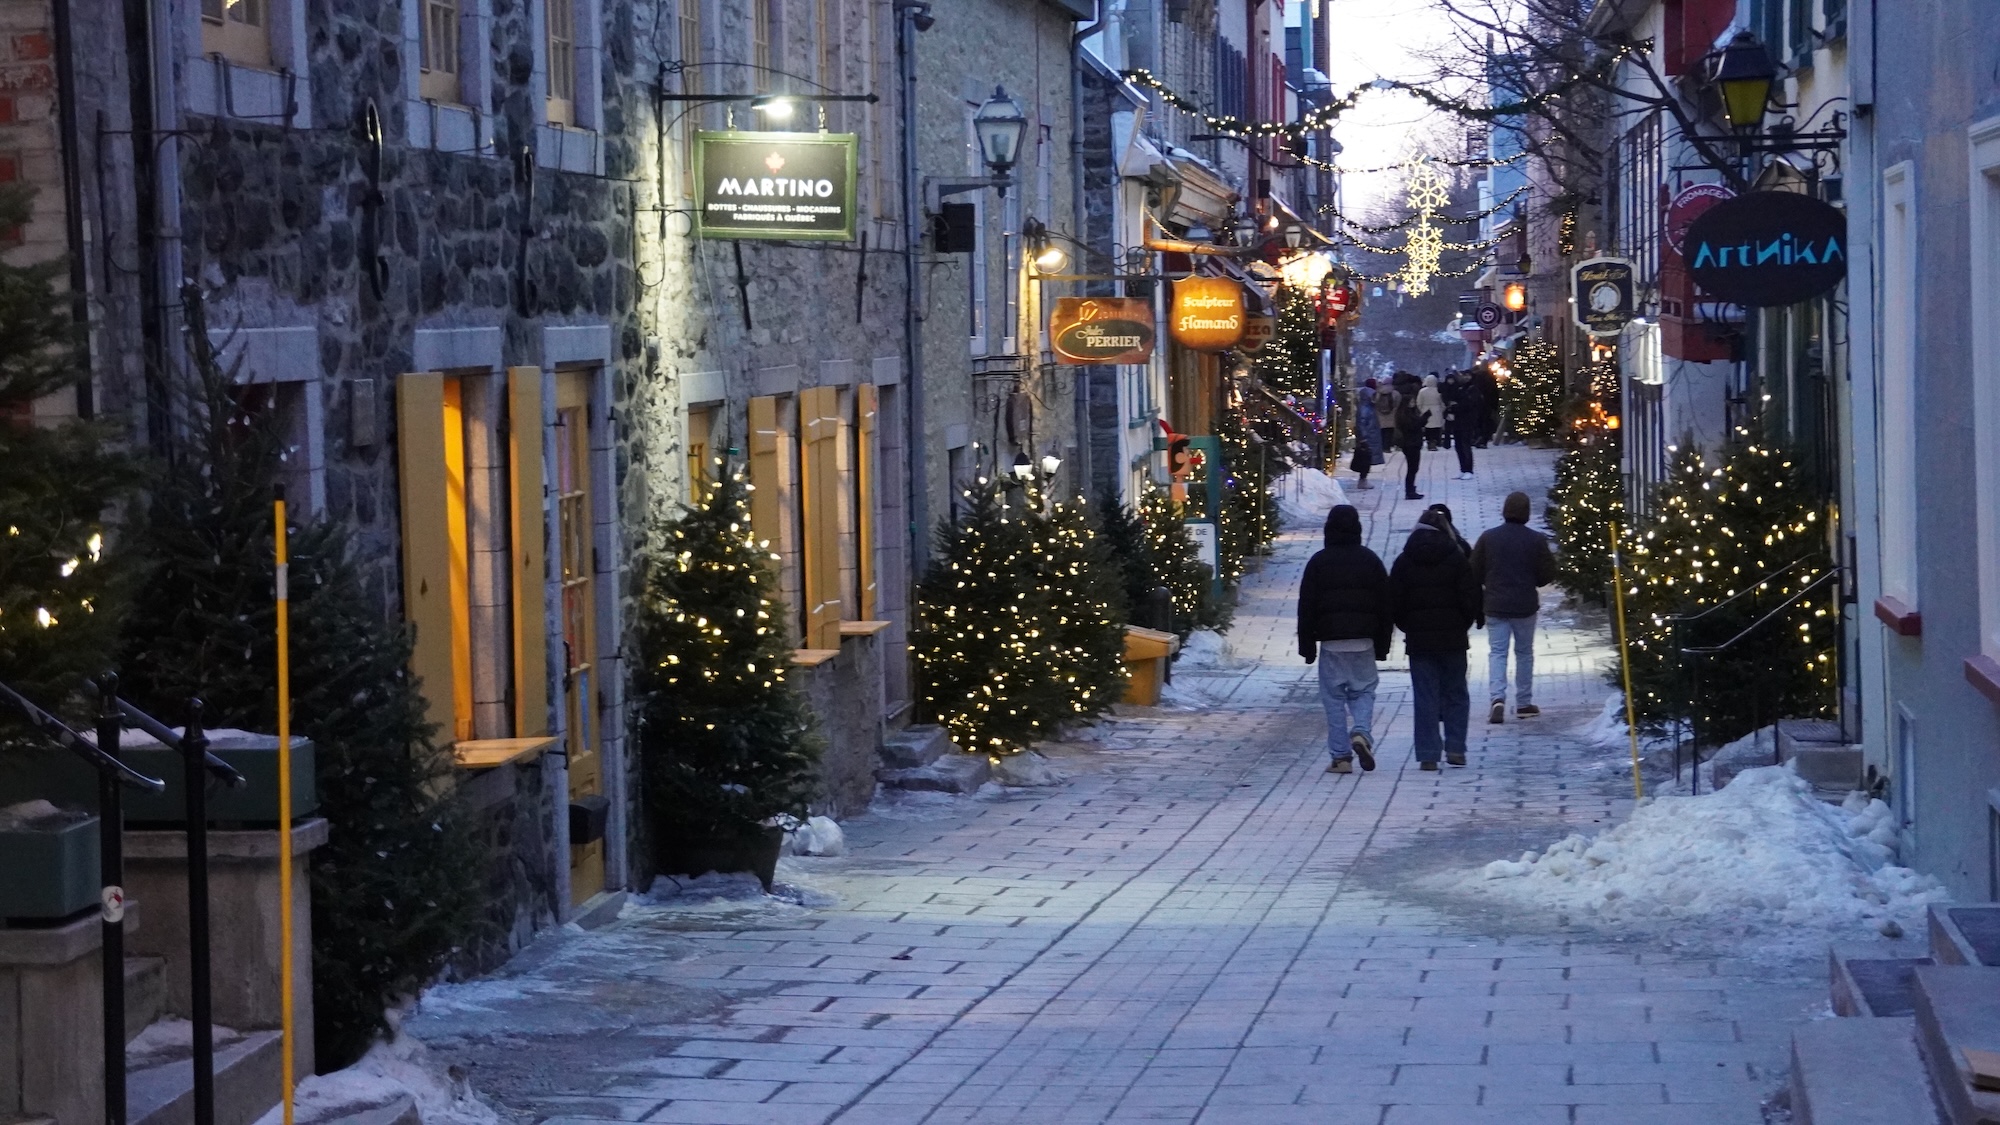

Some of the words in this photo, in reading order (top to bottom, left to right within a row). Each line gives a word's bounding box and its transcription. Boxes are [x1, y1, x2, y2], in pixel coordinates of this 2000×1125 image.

[717, 177, 833, 197] MARTINO
[707, 203, 737, 211] BOTTES
[742, 204, 791, 213] CHAUSSURES
[796, 205, 841, 214] MOCASSINS
[732, 212, 775, 221] FABRIQUÉS
[776, 212, 784, 221] À
[784, 213, 816, 223] QUÉBEC
[1182, 295, 1235, 309] Sculpteur
[1075, 325, 1105, 339] Jules
[1086, 335, 1143, 351] PERRIER
